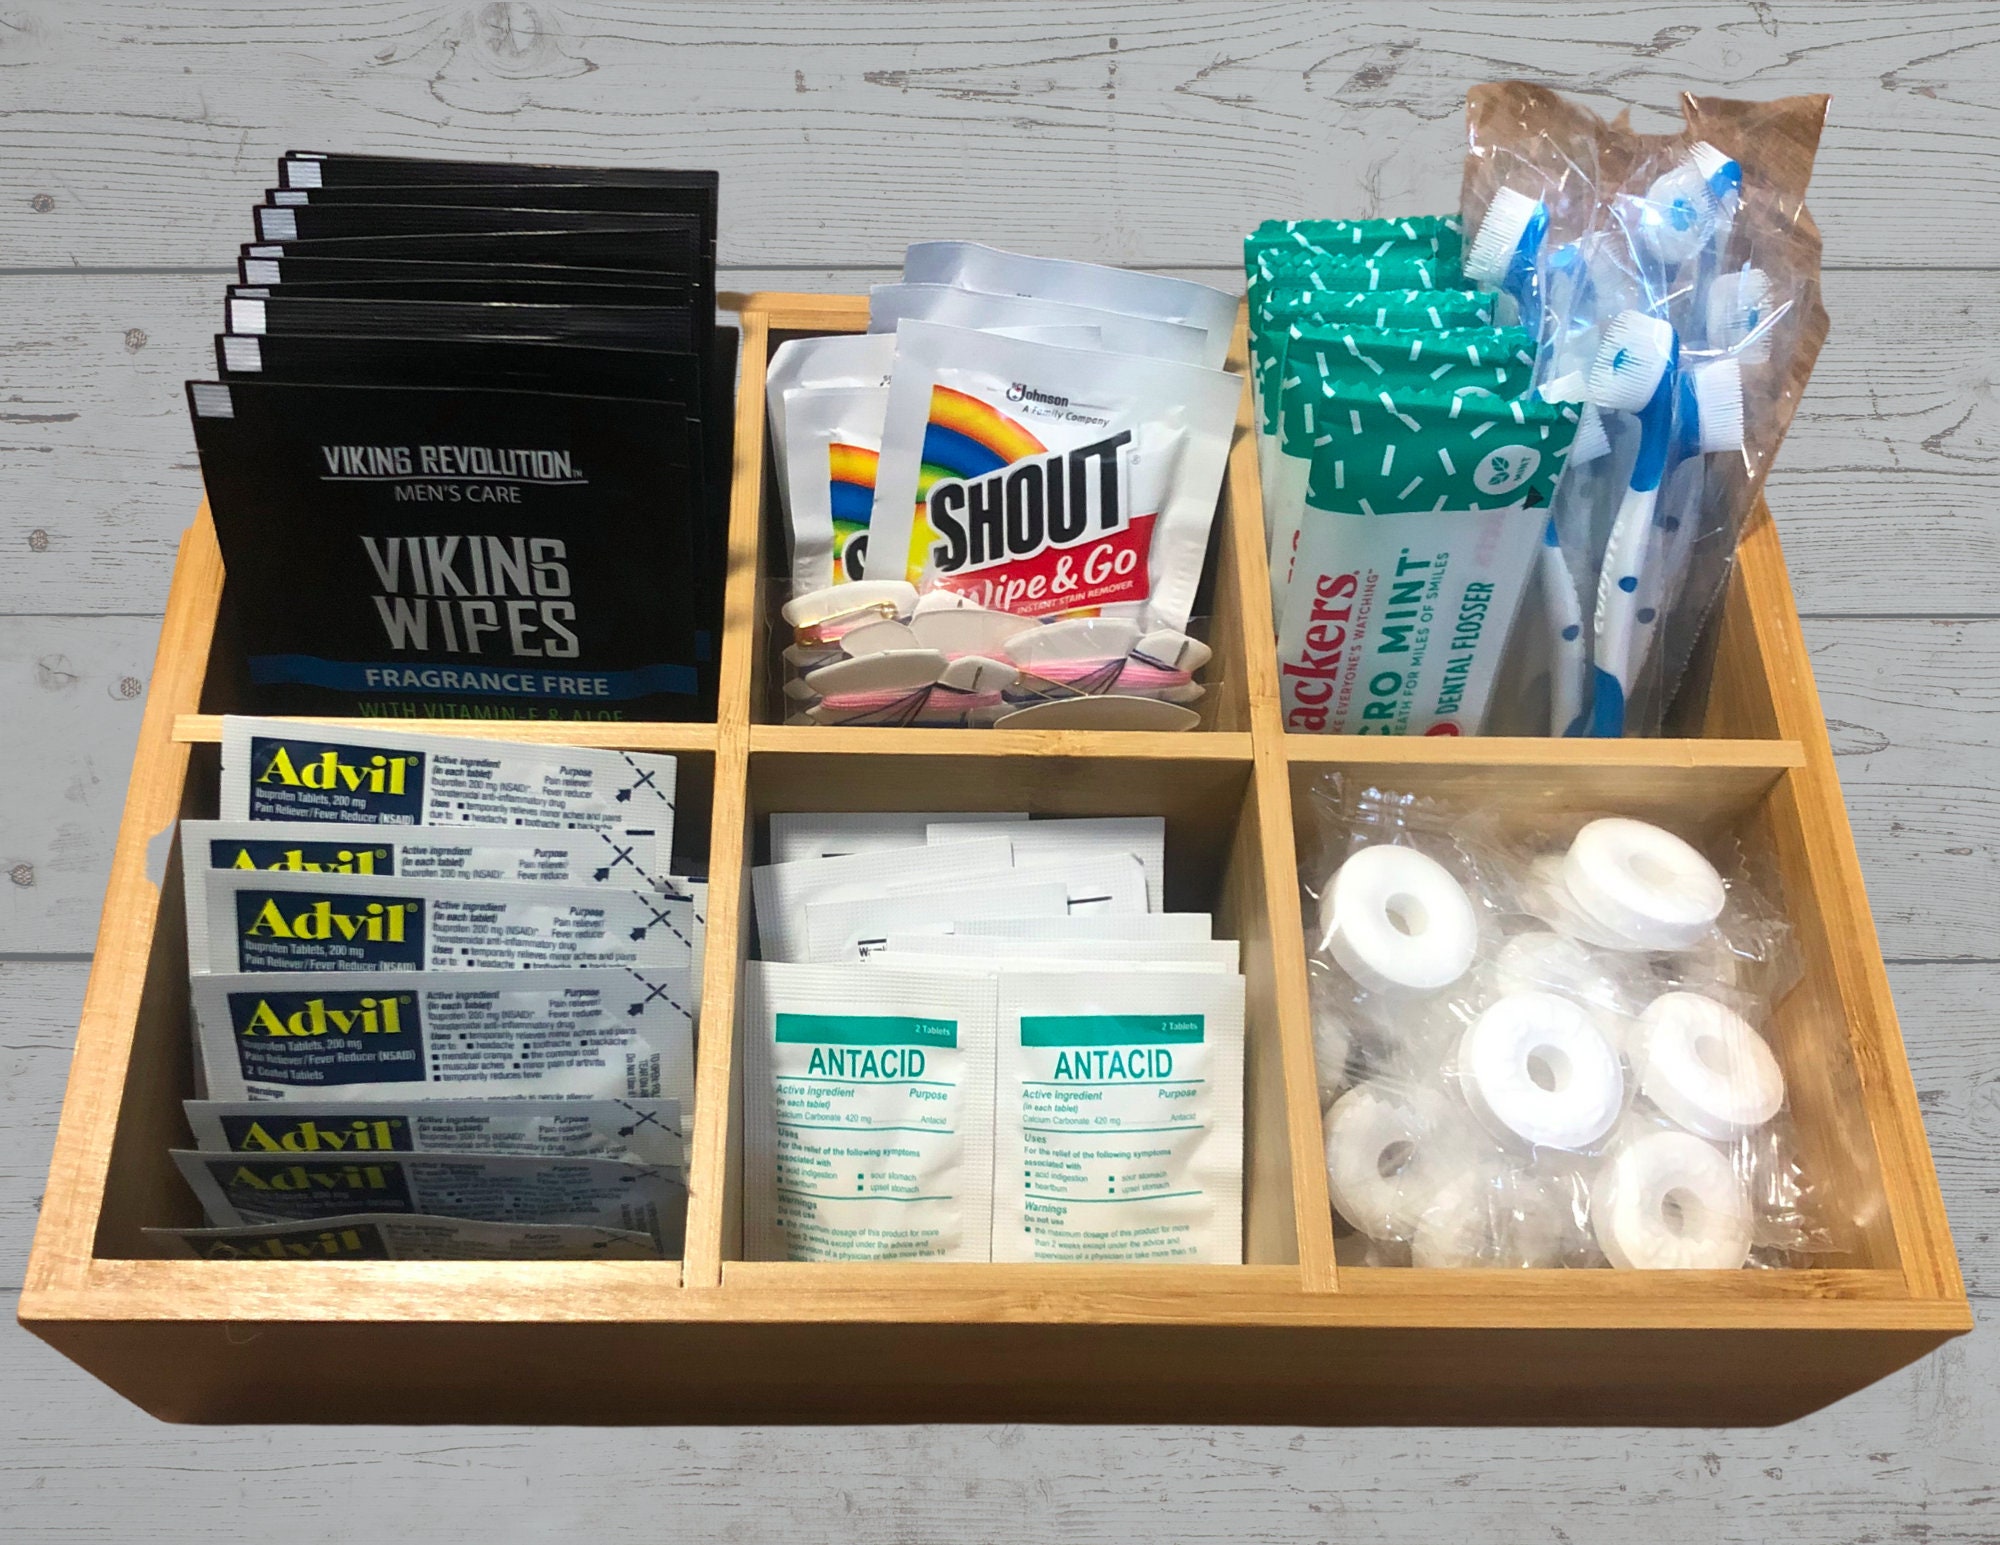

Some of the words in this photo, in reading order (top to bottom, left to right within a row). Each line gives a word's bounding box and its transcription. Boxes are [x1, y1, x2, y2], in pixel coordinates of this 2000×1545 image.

[1006, 385, 1069, 407] Johnson
[1022, 405, 1029, 413] A
[1065, 411, 1110, 428] Company
[322, 446, 412, 475] VIKING
[1513, 457, 1531, 481] MINT
[395, 485, 461, 502] MEN'S
[465, 485, 522, 503] CARE
[931, 430, 1132, 573] SHOUT
[359, 535, 571, 597] VIKING
[1426, 552, 1449, 600] SMILES
[1017, 600, 1057, 614] INSTANT
[1059, 593, 1086, 605] STAIN
[1088, 580, 1133, 599] REMOVER
[1420, 604, 1434, 624] OF
[1451, 581, 1495, 651] FLOSSER
[372, 595, 580, 658] WIPES
[1411, 627, 1430, 665] MILES
[365, 669, 536, 692] FRAGRANCE
[543, 677, 610, 695] FREE
[1336, 645, 1363, 716] EVERYONE'S
[1403, 671, 1419, 696] FOR
[1435, 653, 1473, 715] DENTAL
[359, 702, 416, 718] WITH
[433, 755, 457, 765] Active
[460, 758, 501, 769] ingredient
[559, 766, 593, 778] Purpose
[255, 787, 296, 802] Ibuprofen
[333, 795, 350, 805] 200
[351, 797, 366, 810] mg
[255, 802, 274, 813] Pain
[340, 811, 376, 822] Reducer
[402, 846, 428, 855] Active
[430, 847, 473, 857] ingredient
[533, 848, 568, 859] Purpose
[433, 900, 460, 910] Active
[462, 903, 507, 913] ingredient
[570, 907, 605, 917] Purpose
[244, 940, 289, 955] Ibuprofen
[329, 945, 347, 955] 200
[349, 947, 364, 959] mg
[244, 954, 265, 965] Pain
[338, 960, 377, 971] Reducer
[915, 1025, 920, 1033] 2
[923, 1026, 950, 1036] Tablets
[1162, 1022, 1167, 1031] 2
[1169, 1021, 1198, 1031] Tablets
[327, 1039, 344, 1049] 200
[346, 1039, 362, 1050] mg
[337, 1051, 376, 1063] Reducer
[808, 1047, 925, 1078] ANTACID
[1054, 1048, 1173, 1080] ANTACID
[777, 1084, 804, 1095] Active
[807, 1086, 854, 1098] ingredient
[909, 1088, 948, 1100] Purpose
[1022, 1089, 1053, 1100] Active
[1054, 1090, 1103, 1103] ingredient
[1158, 1088, 1197, 1099] Purpose
[787, 1099, 804, 1108] each
[806, 1100, 830, 1109] tablet)
[1022, 1104, 1032, 1112] (in
[1034, 1104, 1052, 1112] each
[1054, 1104, 1079, 1114] tablet)
[777, 1110, 803, 1120] Calcium
[805, 1112, 841, 1122] Carbonate
[845, 1114, 859, 1122] 420
[860, 1115, 872, 1124] mg
[921, 1116, 947, 1125] Antacid
[1022, 1114, 1051, 1124] Calcium
[1052, 1115, 1090, 1125] Carbonate
[1093, 1116, 1108, 1125] 420
[1109, 1117, 1121, 1126] mg
[778, 1128, 799, 1140] Uses
[1024, 1133, 1047, 1144] Uses
[777, 1140, 790, 1149] For
[823, 1147, 831, 1155] of
[833, 1148, 845, 1156] the
[846, 1148, 881, 1159] following
[883, 1148, 920, 1158] symptoms
[1024, 1146, 1037, 1154] For
[1039, 1147, 1051, 1155] the
[1052, 1148, 1071, 1157] relief
[1072, 1149, 1081, 1158] of
[1082, 1150, 1095, 1158] the
[1096, 1150, 1131, 1159] following
[1133, 1149, 1171, 1159] symptoms
[816, 1158, 831, 1167] with
[1024, 1159, 1064, 1169] associated
[1066, 1162, 1082, 1170] with
[1025, 1201, 1067, 1216] Warnings
[1024, 1214, 1035, 1222] Do
[1037, 1215, 1049, 1225] not
[1051, 1217, 1064, 1225] use
